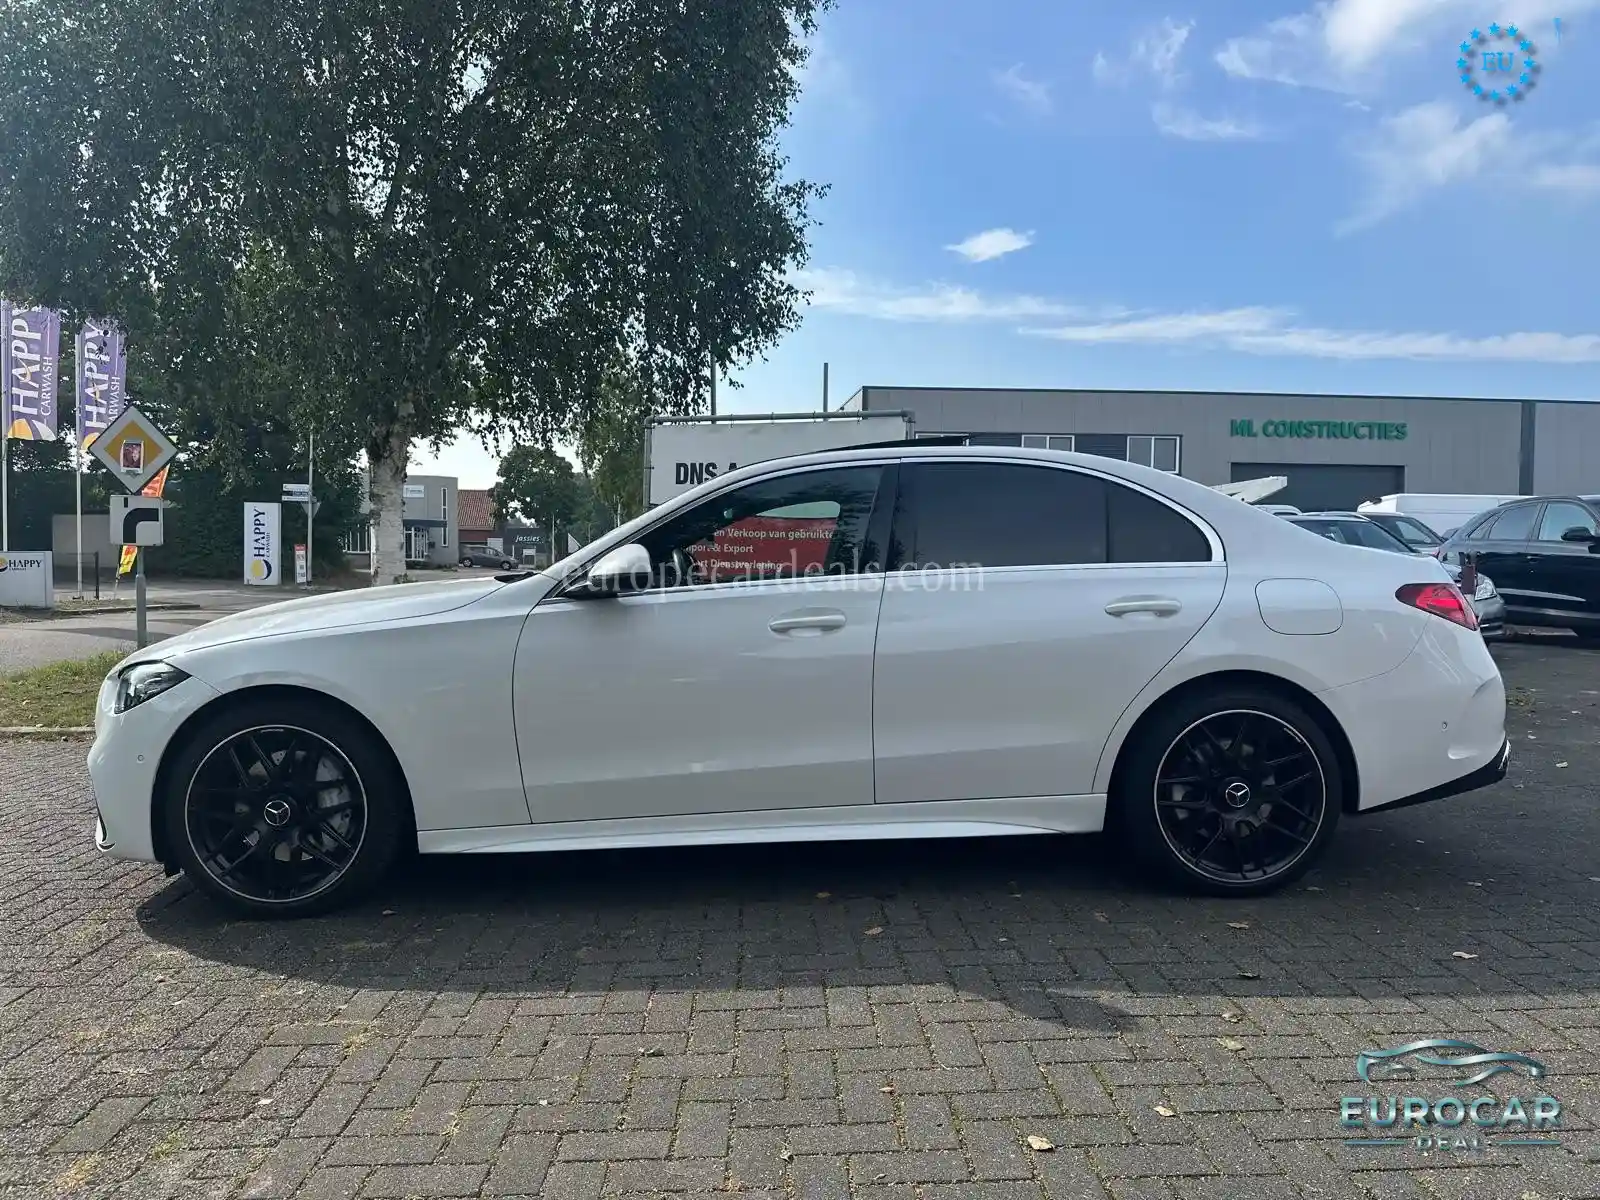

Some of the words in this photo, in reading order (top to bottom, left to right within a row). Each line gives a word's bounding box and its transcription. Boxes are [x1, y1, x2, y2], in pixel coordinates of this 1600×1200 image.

[84, 319, 111, 429] HAPPY
[40, 356, 53, 416] CARWASH
[107, 376, 121, 424] ARWASH
[1230, 419, 1258, 437] ML
[1262, 419, 1408, 440] CONSTRUCTIES
[675, 462, 718, 485] DNS
[253, 508, 266, 557] HAPPY
[727, 529, 767, 539] Verkoop
[723, 544, 753, 554] Export
[9, 560, 42, 568] HAPPY
